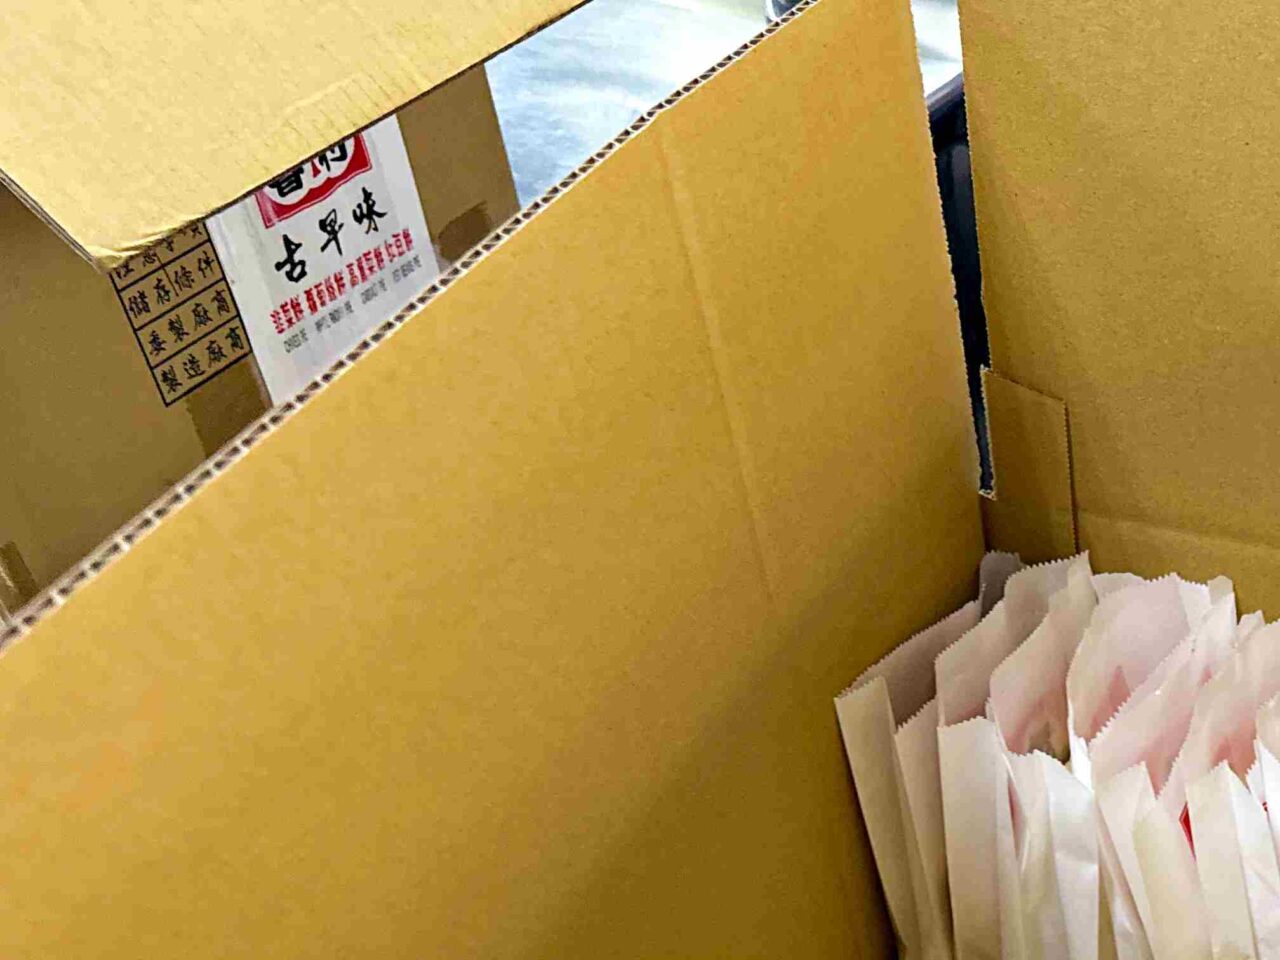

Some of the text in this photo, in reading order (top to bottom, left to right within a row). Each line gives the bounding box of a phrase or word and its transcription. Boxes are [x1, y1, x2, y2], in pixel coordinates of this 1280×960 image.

[274, 187, 388, 283] 古早味
[128, 251, 215, 319] 儲存條件
[148, 288, 231, 357] 委製廠商
[161, 327, 246, 394] 製造廠商
